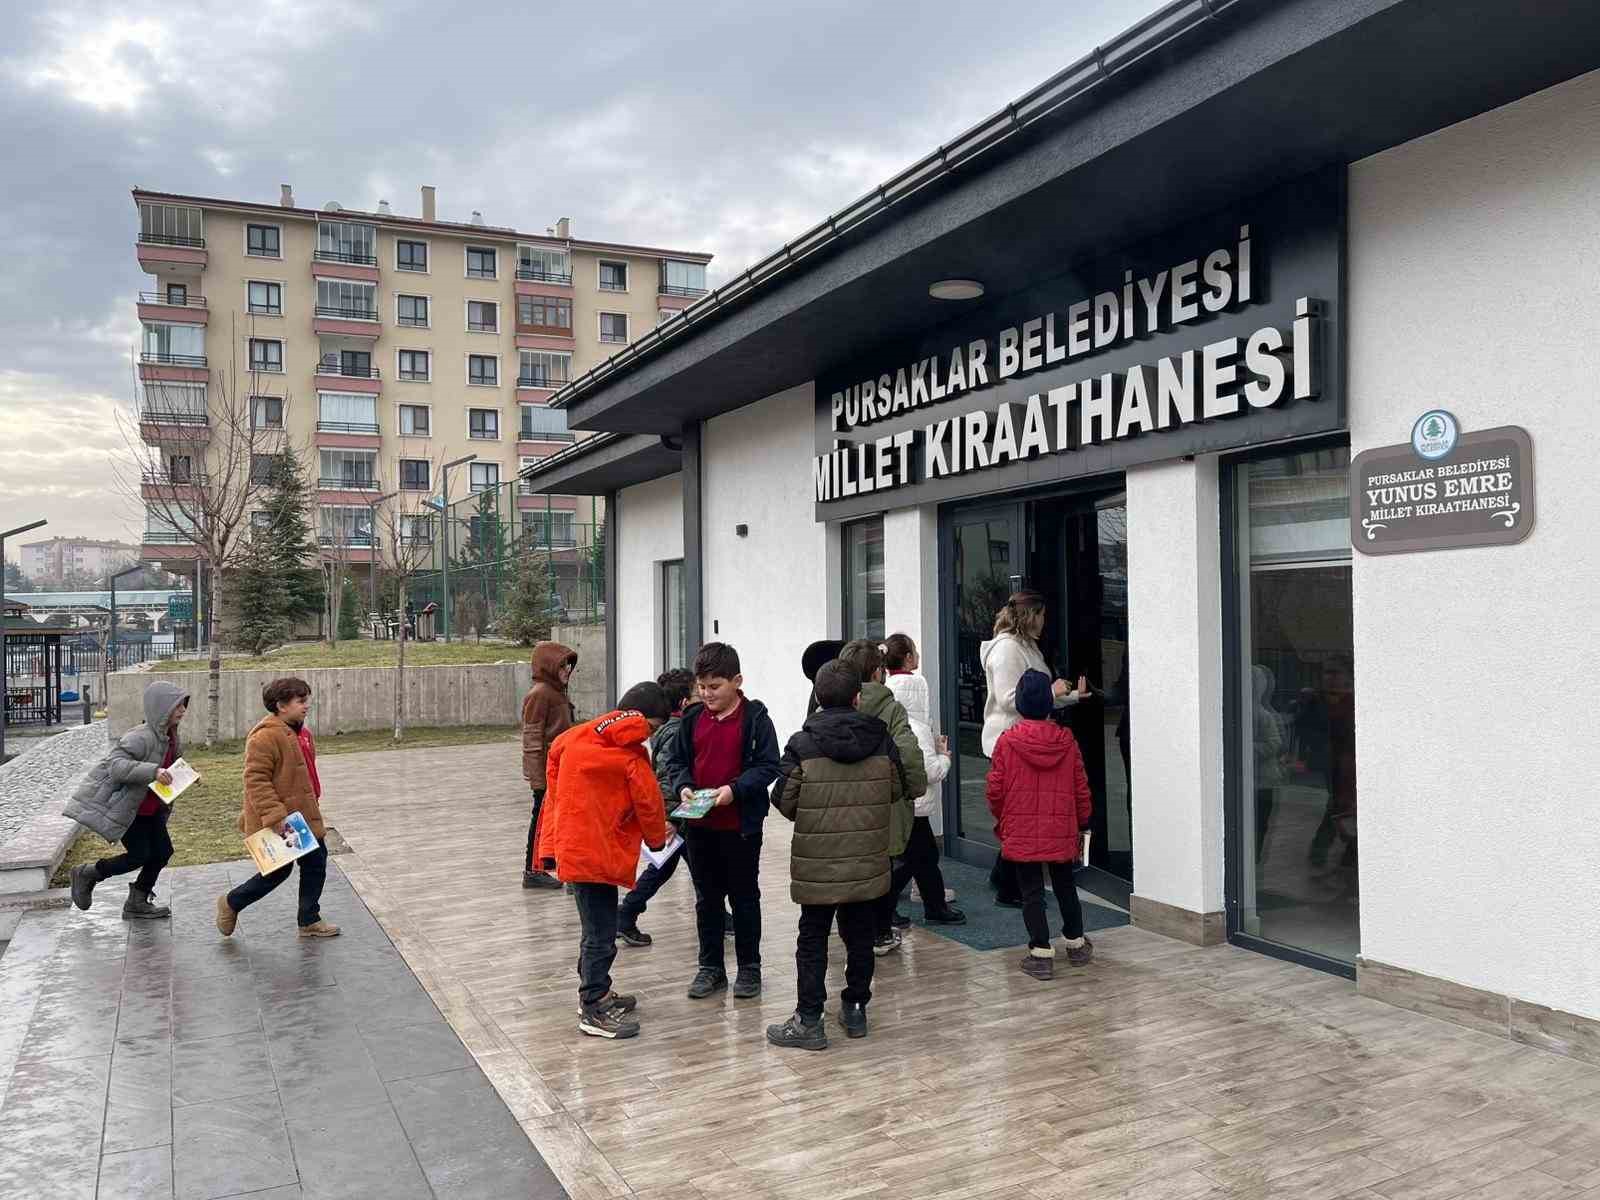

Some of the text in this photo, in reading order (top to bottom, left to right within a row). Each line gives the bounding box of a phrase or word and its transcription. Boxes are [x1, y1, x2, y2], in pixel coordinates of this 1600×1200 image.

[831, 224, 1251, 432] PURSAKLAR BELEDİYESİ
[812, 296, 1311, 503] MİLLET KIRAATHANESİ
[1368, 455, 1512, 487] PURSAKLAR BELEDİYESİ
[1366, 472, 1513, 506] YUNUS EMRE
[1370, 492, 1511, 521] MİLLET KIRAATHANESİ
